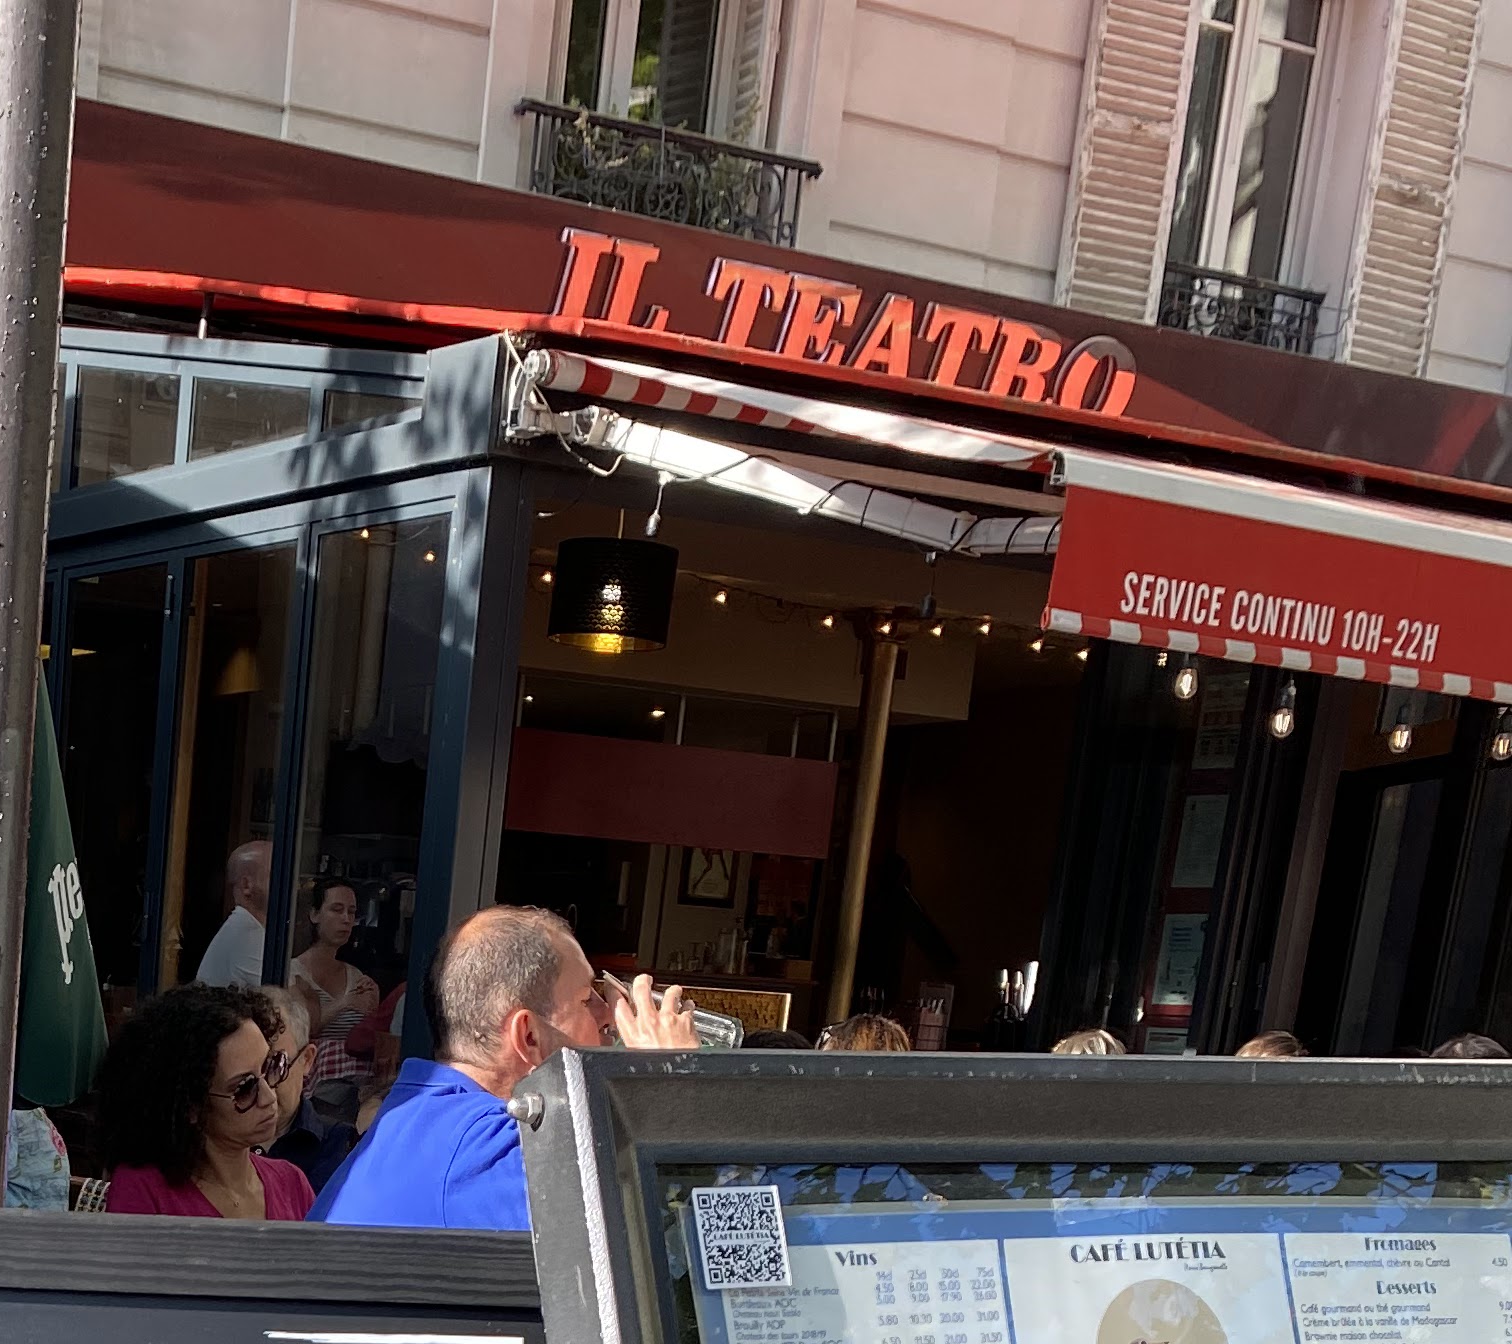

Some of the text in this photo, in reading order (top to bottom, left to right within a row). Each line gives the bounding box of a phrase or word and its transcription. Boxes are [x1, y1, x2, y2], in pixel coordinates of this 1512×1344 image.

[550, 225, 1140, 422] IL TEATRO
[1119, 570, 1440, 663] SERVICE CONTINU 10H-22H
[1069, 1236, 1225, 1262] CAFÉ LUTÉTIA
[1364, 1235, 1436, 1252] Fromages
[835, 1249, 877, 1266] Vins
[1376, 1279, 1436, 1296] Desserts
